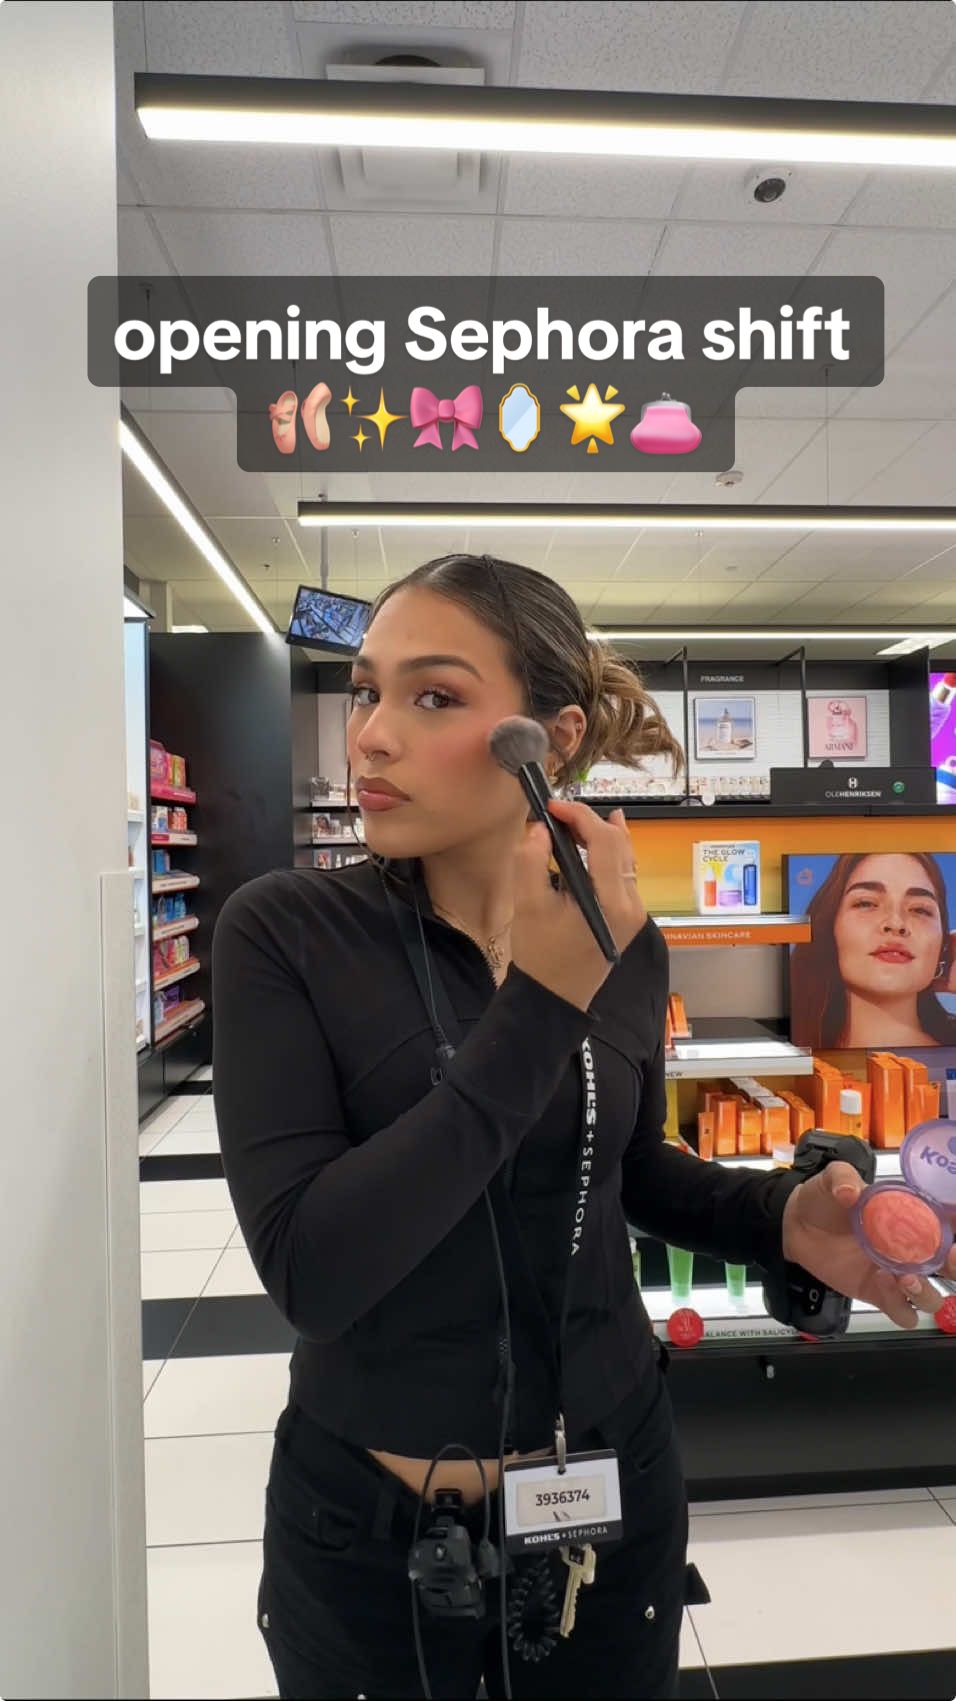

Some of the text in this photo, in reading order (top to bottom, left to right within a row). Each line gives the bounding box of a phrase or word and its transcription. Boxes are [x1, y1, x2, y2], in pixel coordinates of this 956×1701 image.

[700, 674, 744, 682] FRAGRANCE
[571, 1147, 593, 1256] SEPHORA
[705, 1329, 737, 1337] ALANCE
[739, 1328, 761, 1336] WITH
[535, 1489, 590, 1507] 3936374
[567, 1526, 608, 1540] SEPHORA
